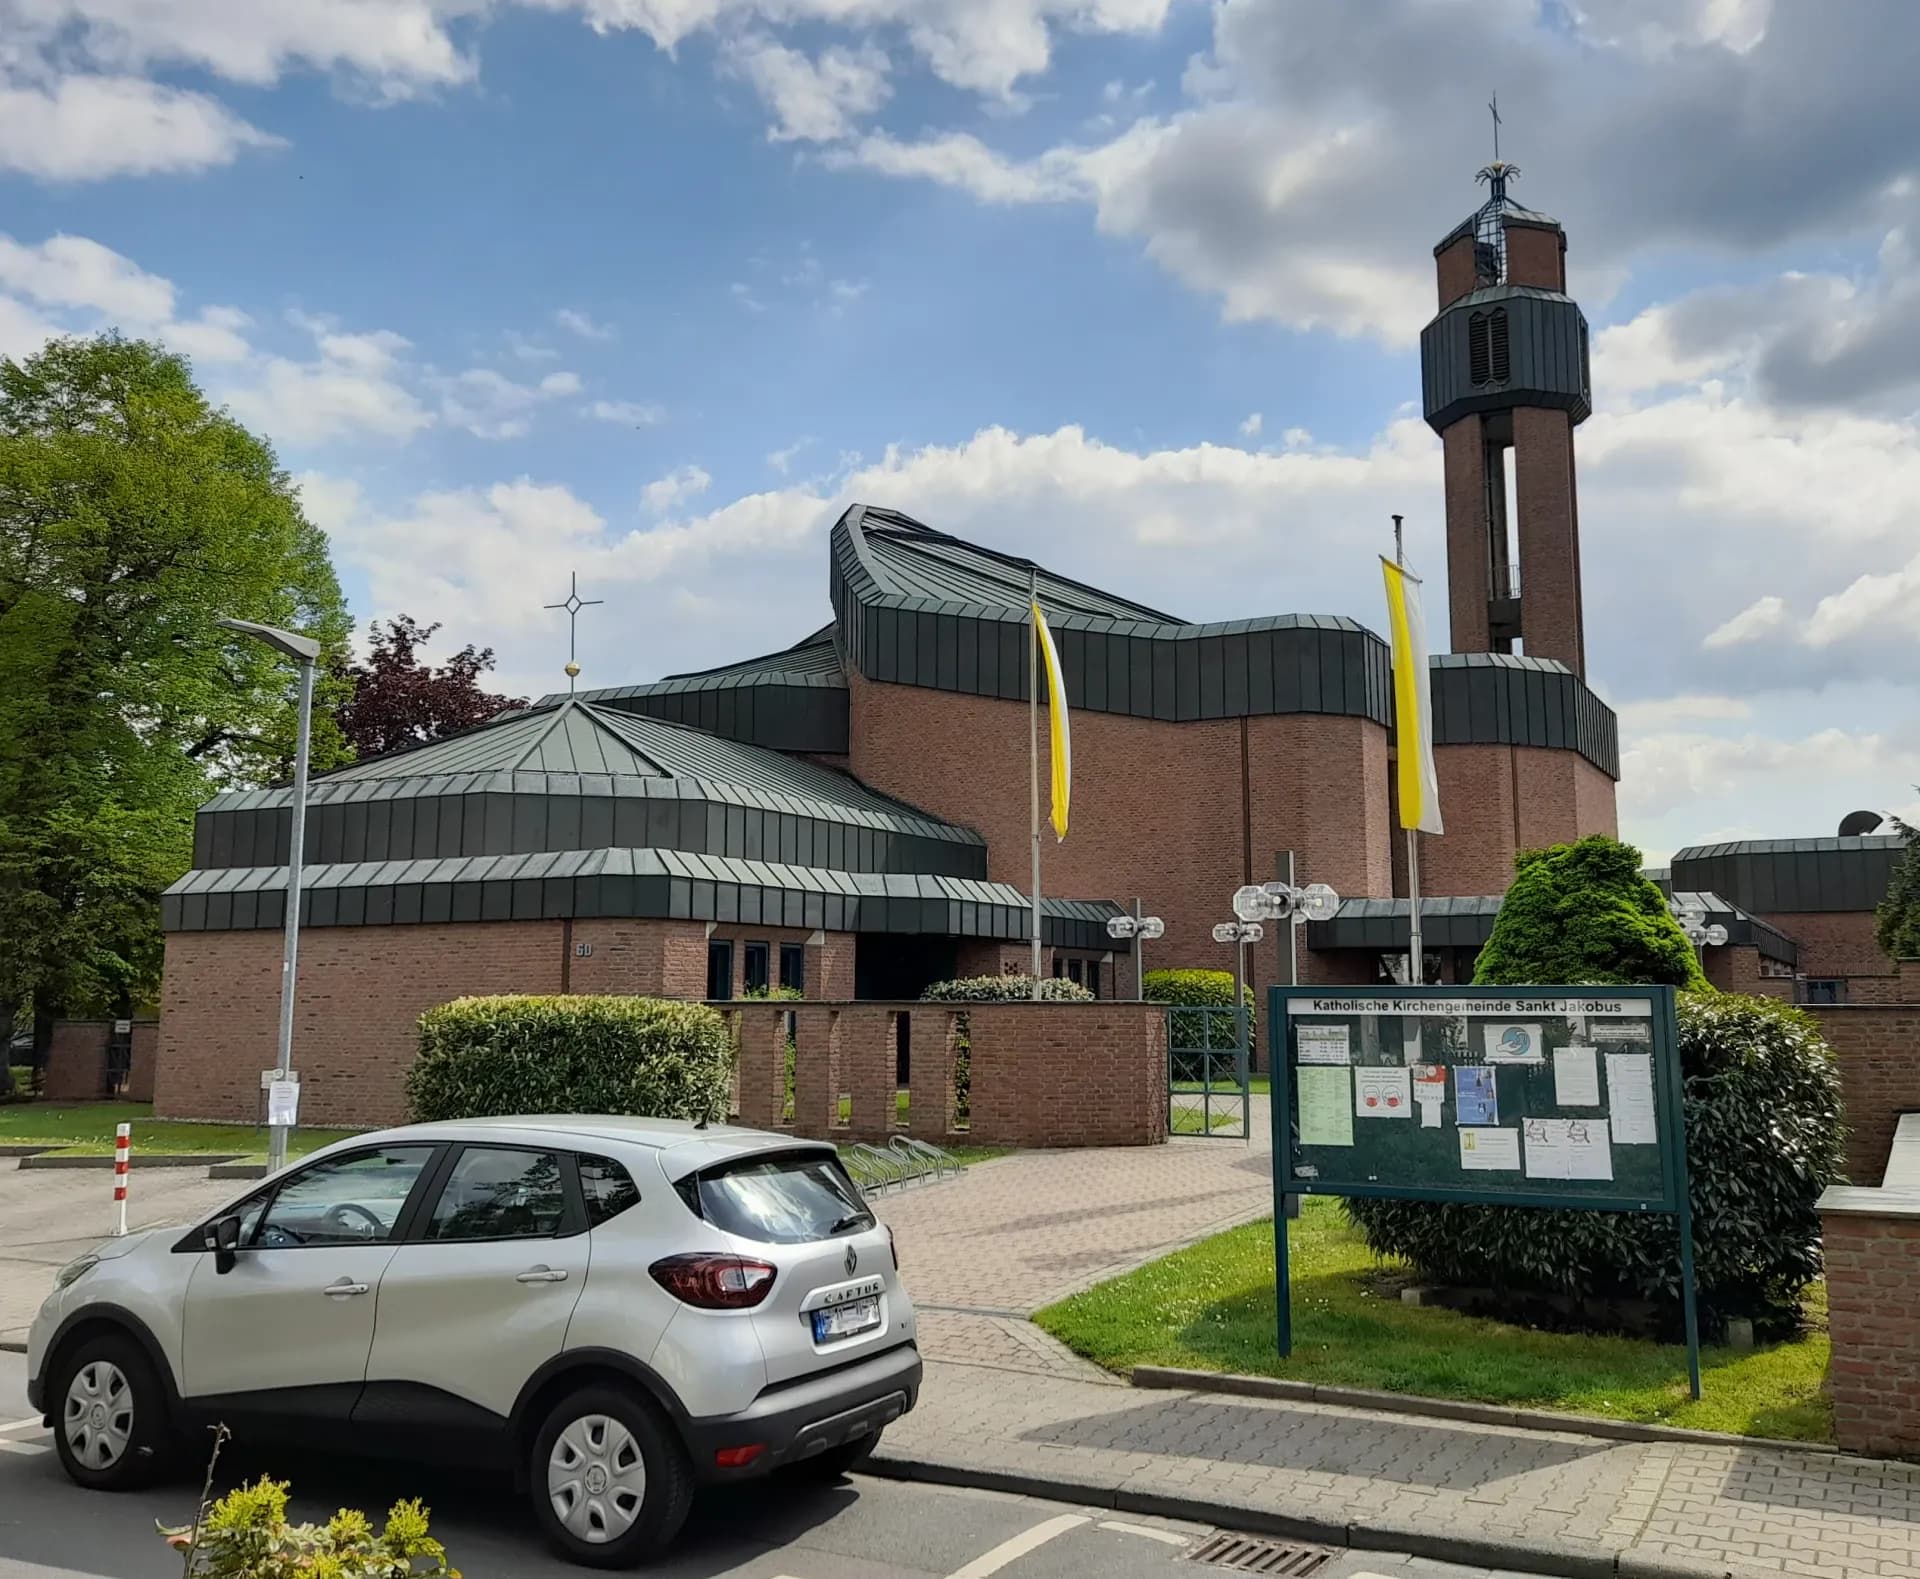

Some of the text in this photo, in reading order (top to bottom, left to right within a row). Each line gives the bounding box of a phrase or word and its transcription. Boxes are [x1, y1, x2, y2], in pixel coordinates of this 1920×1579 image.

[1313, 1000, 1622, 1014] Katholische Kirchengemeinde Sankt Jakobus
[824, 1282, 879, 1303] CAPTUR
